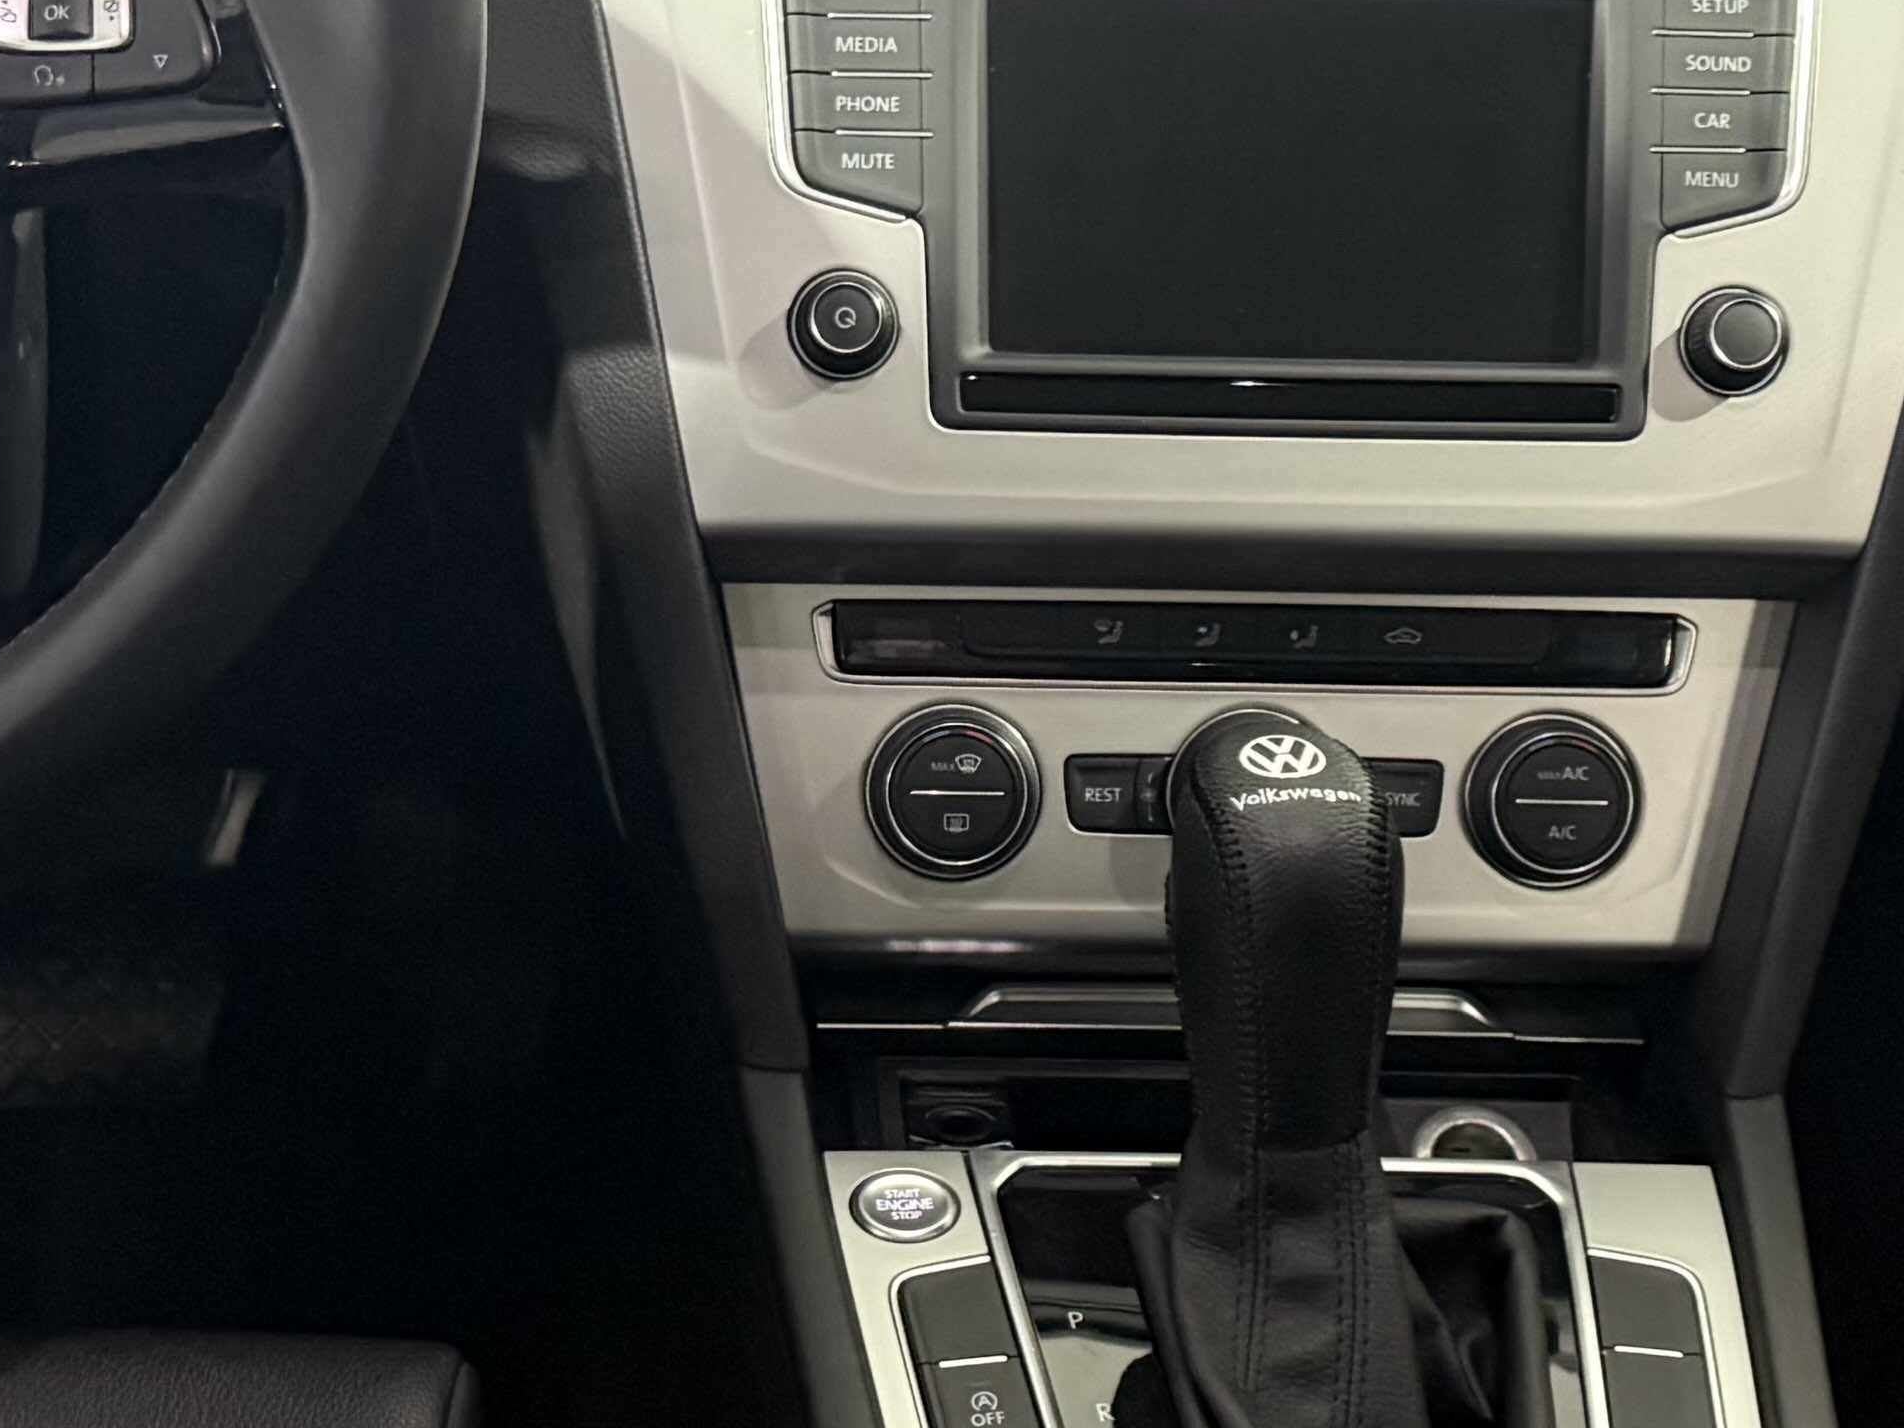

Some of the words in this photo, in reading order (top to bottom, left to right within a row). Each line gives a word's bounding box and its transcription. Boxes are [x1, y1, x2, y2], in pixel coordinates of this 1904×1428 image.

[44, 5, 70, 21] OK
[835, 36, 898, 54] MEDIA
[1684, 55, 1752, 73] SOUND
[835, 95, 900, 113] PHONE
[1694, 112, 1730, 129] CAR
[841, 152, 895, 170] MUTE
[1684, 171, 1739, 188] MENU
[1085, 787, 1123, 802] REST
[1229, 787, 1362, 812] Volkswagen
[1386, 792, 1422, 807] SYNC
[1548, 825, 1577, 840] A/C
[884, 1188, 920, 1200] START
[876, 1198, 934, 1212] ENGINE
[891, 1209, 923, 1220] STOP
[1067, 1313, 1084, 1328] P
[970, 1410, 1006, 1427] OFF
[1096, 1404, 1115, 1421] R
